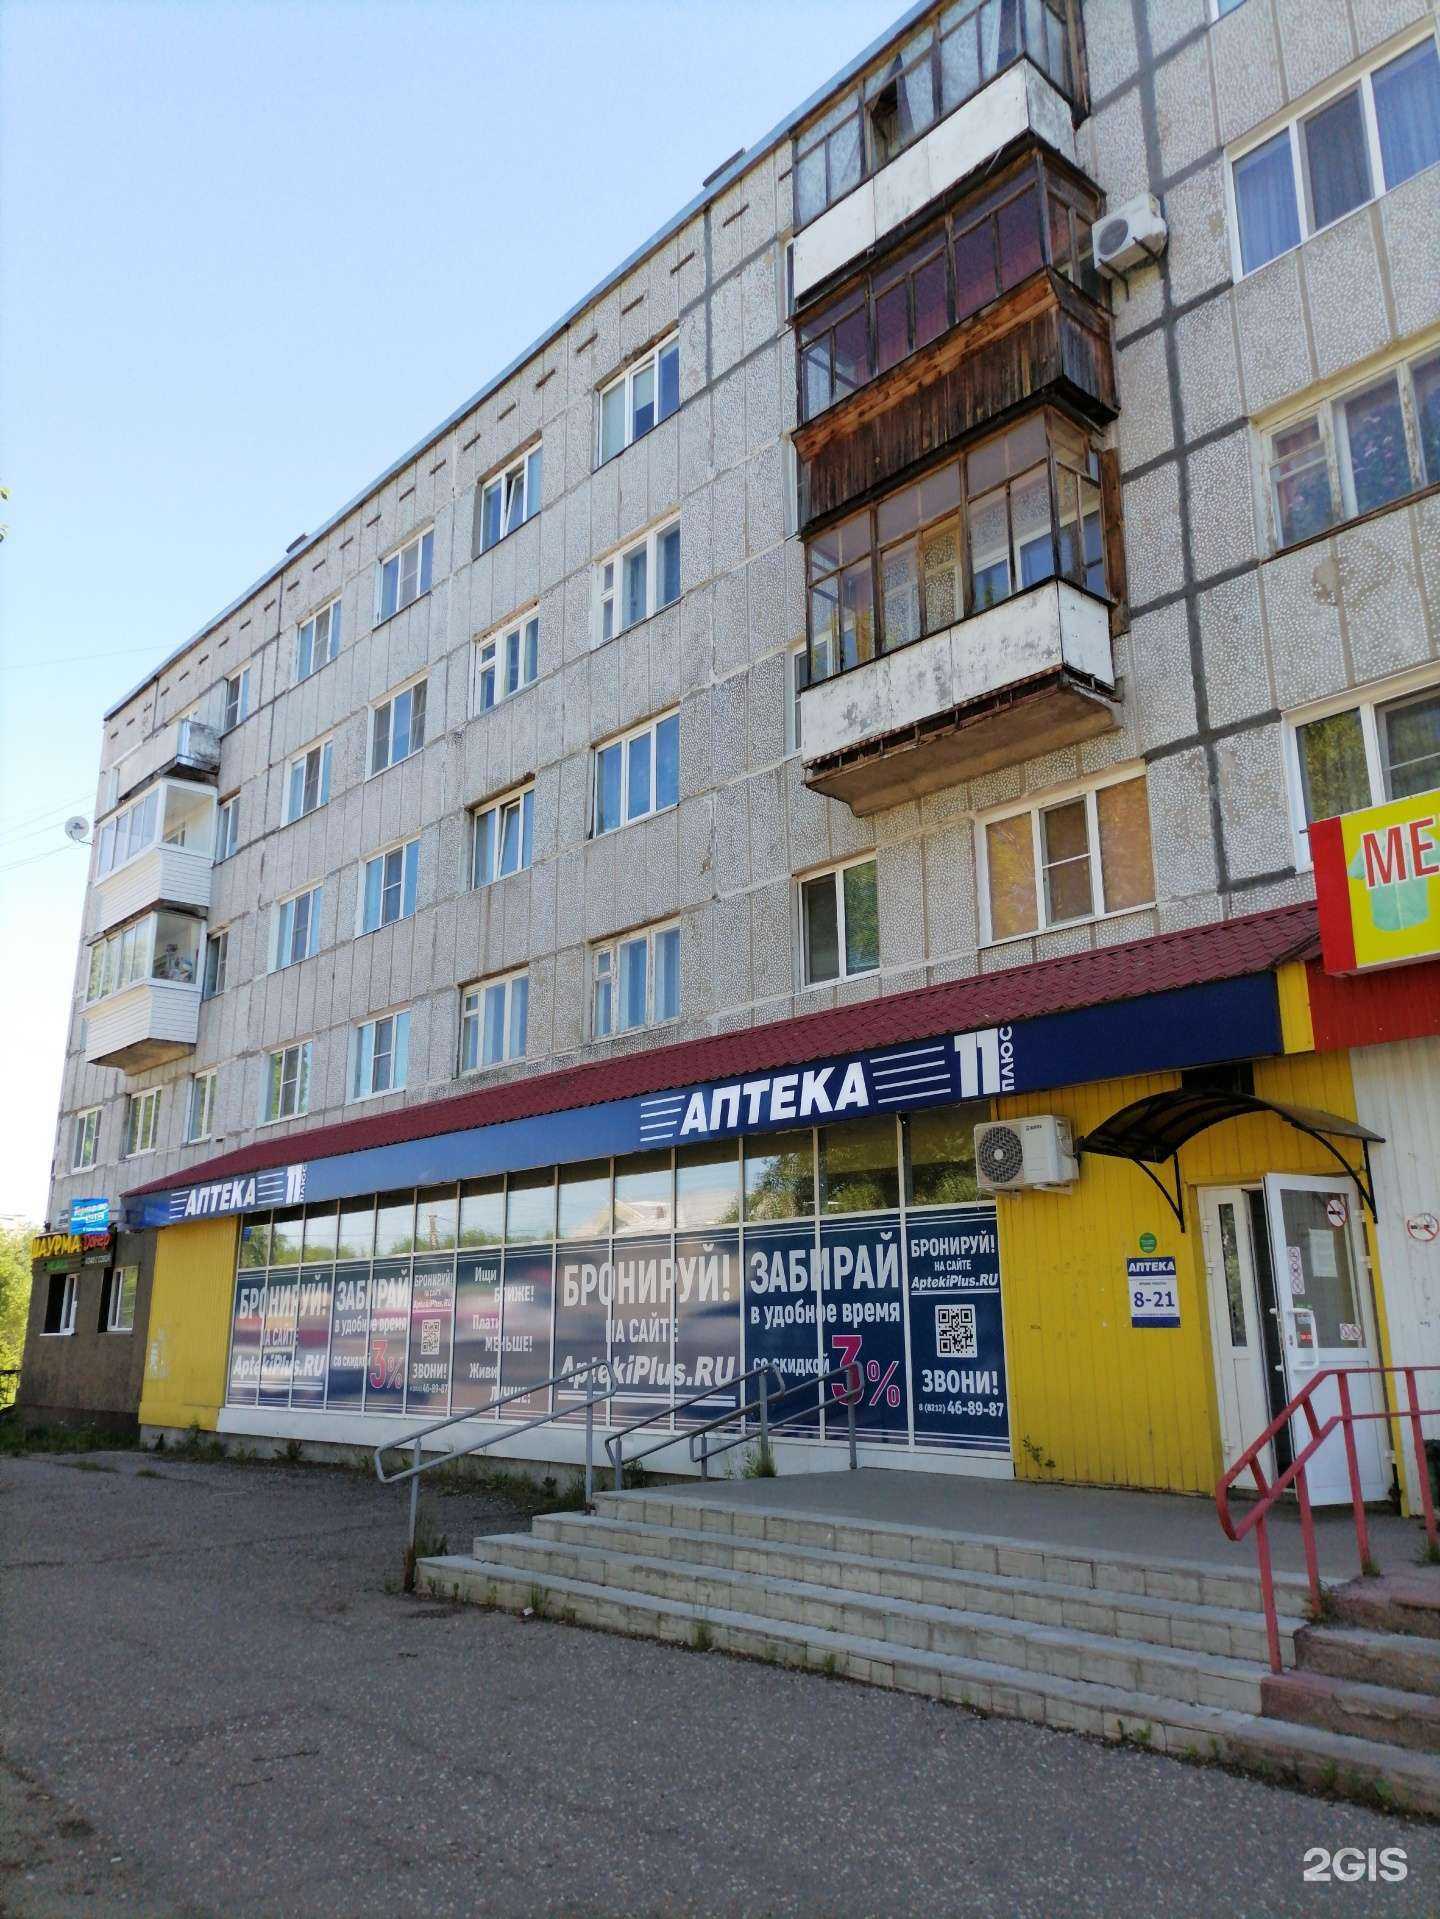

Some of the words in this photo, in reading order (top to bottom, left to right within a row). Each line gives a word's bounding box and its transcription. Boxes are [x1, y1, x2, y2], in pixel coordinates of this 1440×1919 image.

[1361, 814, 1440, 889] МЕ
[1000, 1026, 1015, 1092] ПЛЮС
[680, 1061, 870, 1136] АПТЕКА
[184, 1178, 256, 1216] АПТЕКА
[32, 1234, 80, 1258] ШАУРМА
[910, 1230, 995, 1258] БРОНИРУЙ!
[475, 1267, 496, 1283] Ищи
[563, 1243, 730, 1307] БРОНИРУЙ!
[750, 1231, 899, 1294] ЗАБИРАЙ
[934, 1260, 946, 1272] НА
[946, 1257, 972, 1271] САЙТЕ
[1128, 1261, 1175, 1273] АПТЕКА
[336, 1268, 410, 1311] ЗАБИРАЙ
[911, 1273, 999, 1291] AptekiPlus.RU
[239, 1273, 328, 1319] БРОНИРУЙ!
[1134, 1291, 1175, 1308] 8-21
[750, 1306, 760, 1324] в
[842, 1302, 900, 1329] время
[413, 1363, 447, 1379] ЗВОНИ!
[921, 1369, 999, 1396] ЗВОНИ!
[947, 1400, 1004, 1417] 46-89-87
